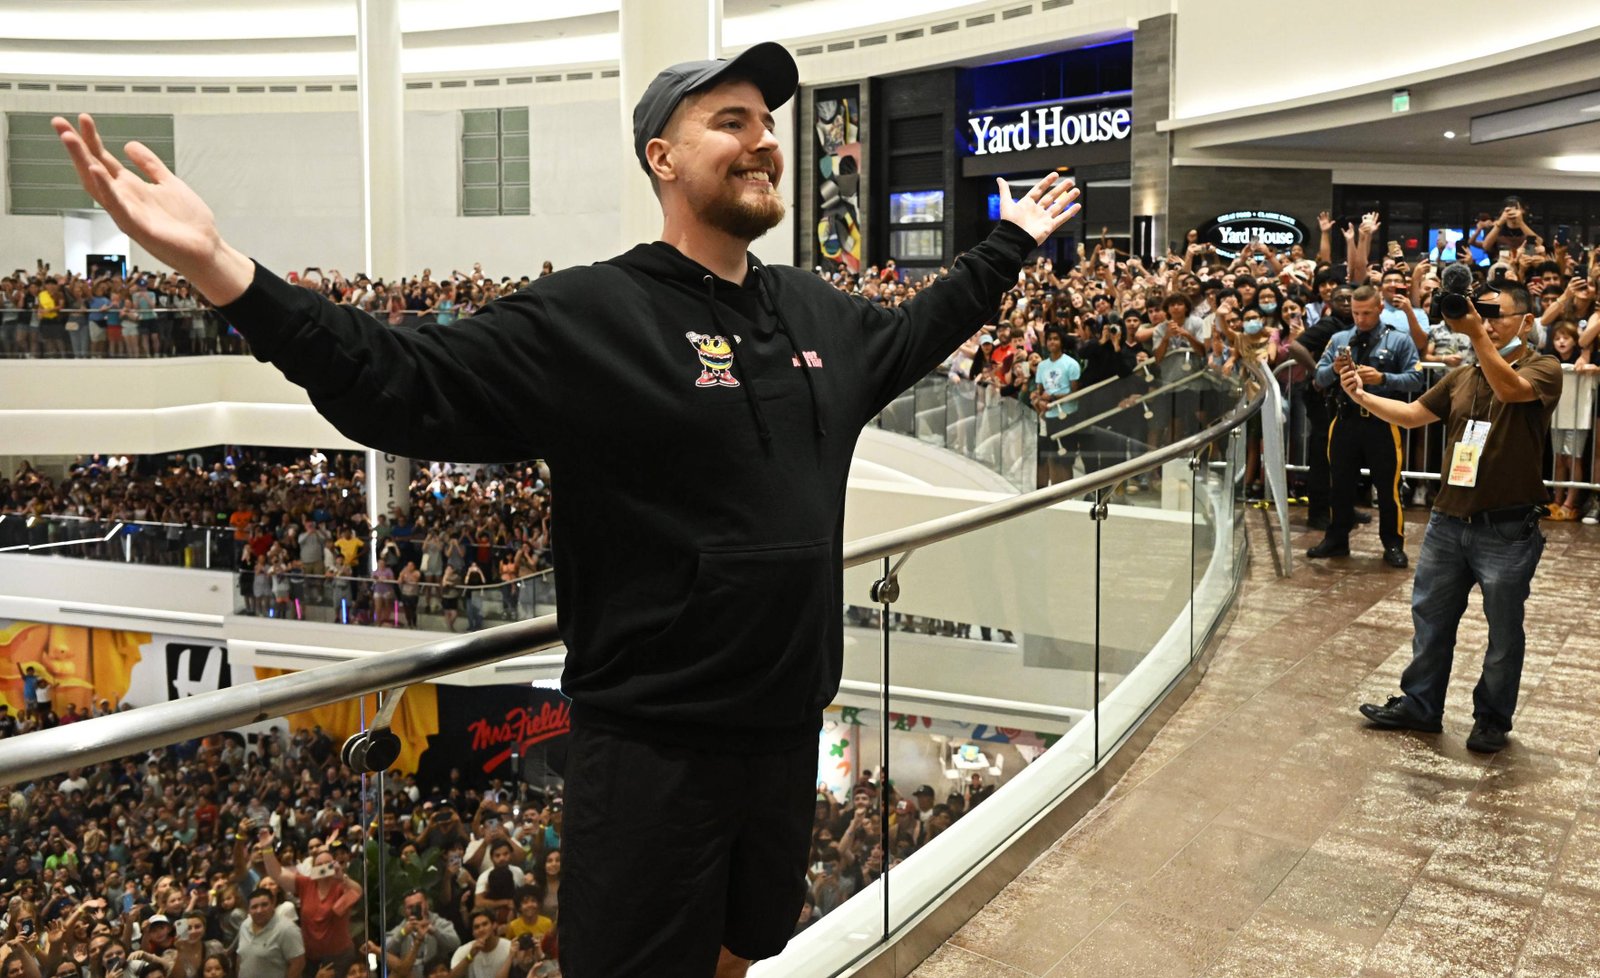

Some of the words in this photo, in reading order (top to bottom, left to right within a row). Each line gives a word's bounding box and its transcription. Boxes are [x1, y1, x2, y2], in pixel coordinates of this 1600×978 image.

[968, 110, 1031, 155] Yard
[1036, 106, 1131, 148] House
[1219, 226, 1250, 244] Yard
[1251, 227, 1294, 245] House
[505, 701, 571, 745] Fields
